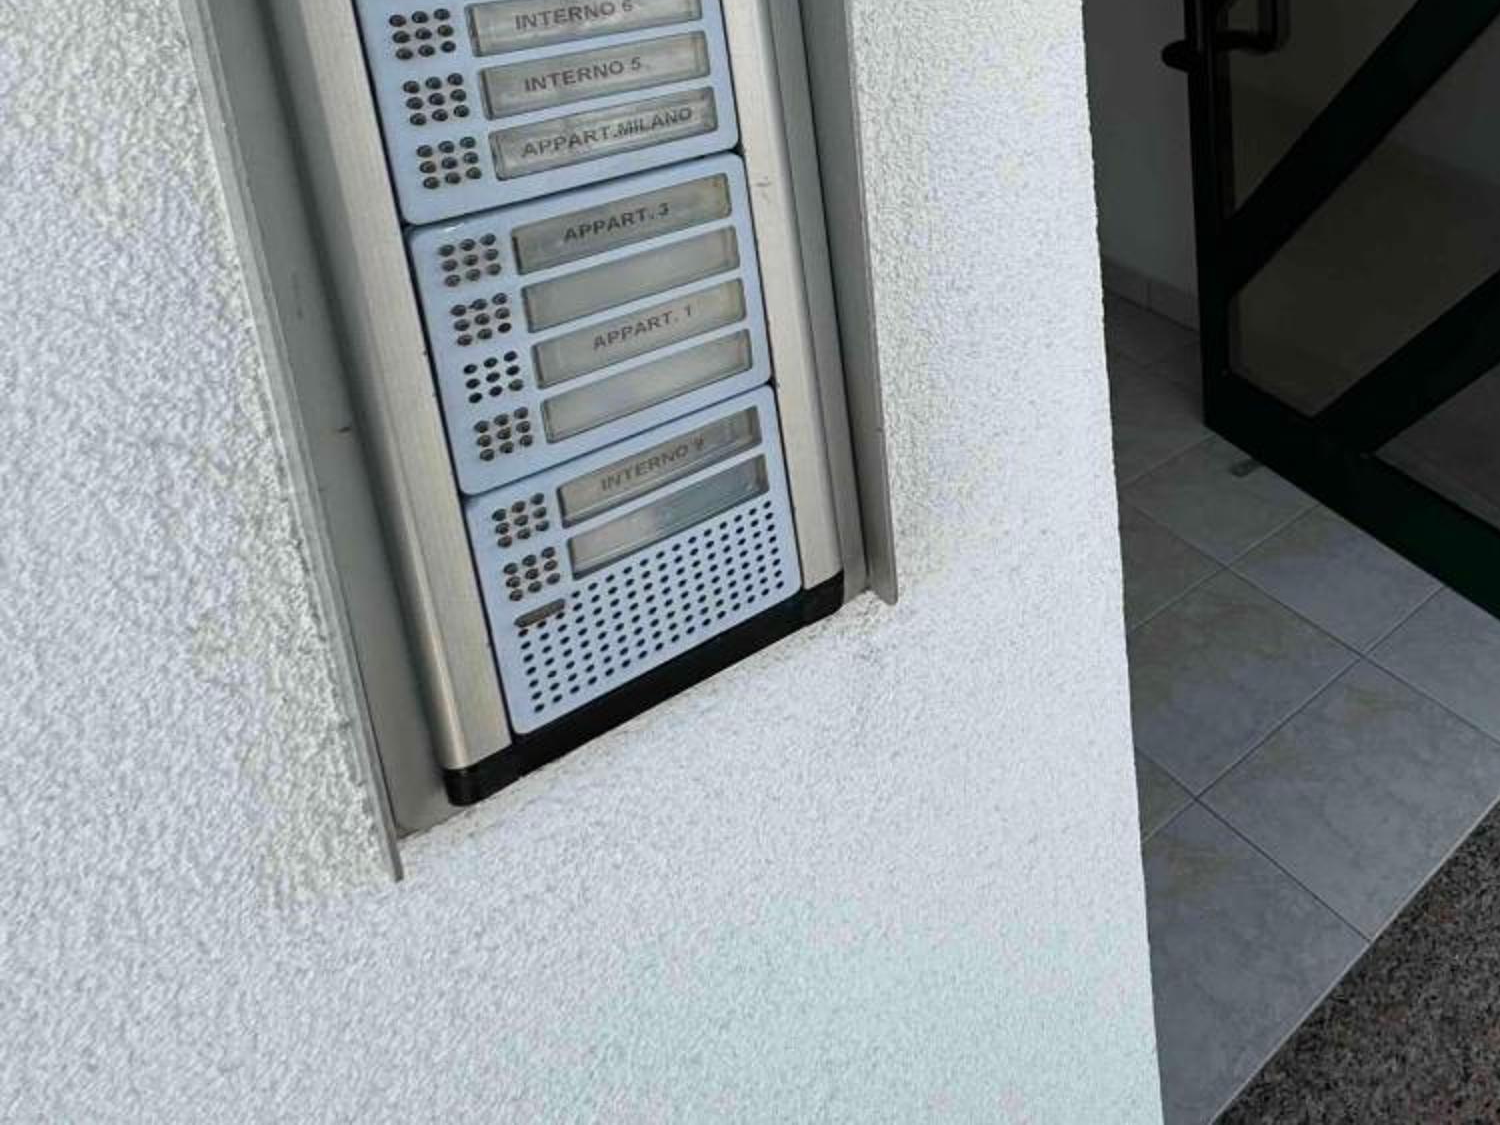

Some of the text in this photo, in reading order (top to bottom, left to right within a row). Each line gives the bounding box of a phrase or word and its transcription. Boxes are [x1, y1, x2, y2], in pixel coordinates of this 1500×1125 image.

[514, 1, 617, 31] INTERNO
[524, 61, 625, 92] INTERNO
[562, 201, 671, 243] APPART. 3
[592, 305, 694, 350] APPART. 1
[601, 446, 688, 492] INTERNO
